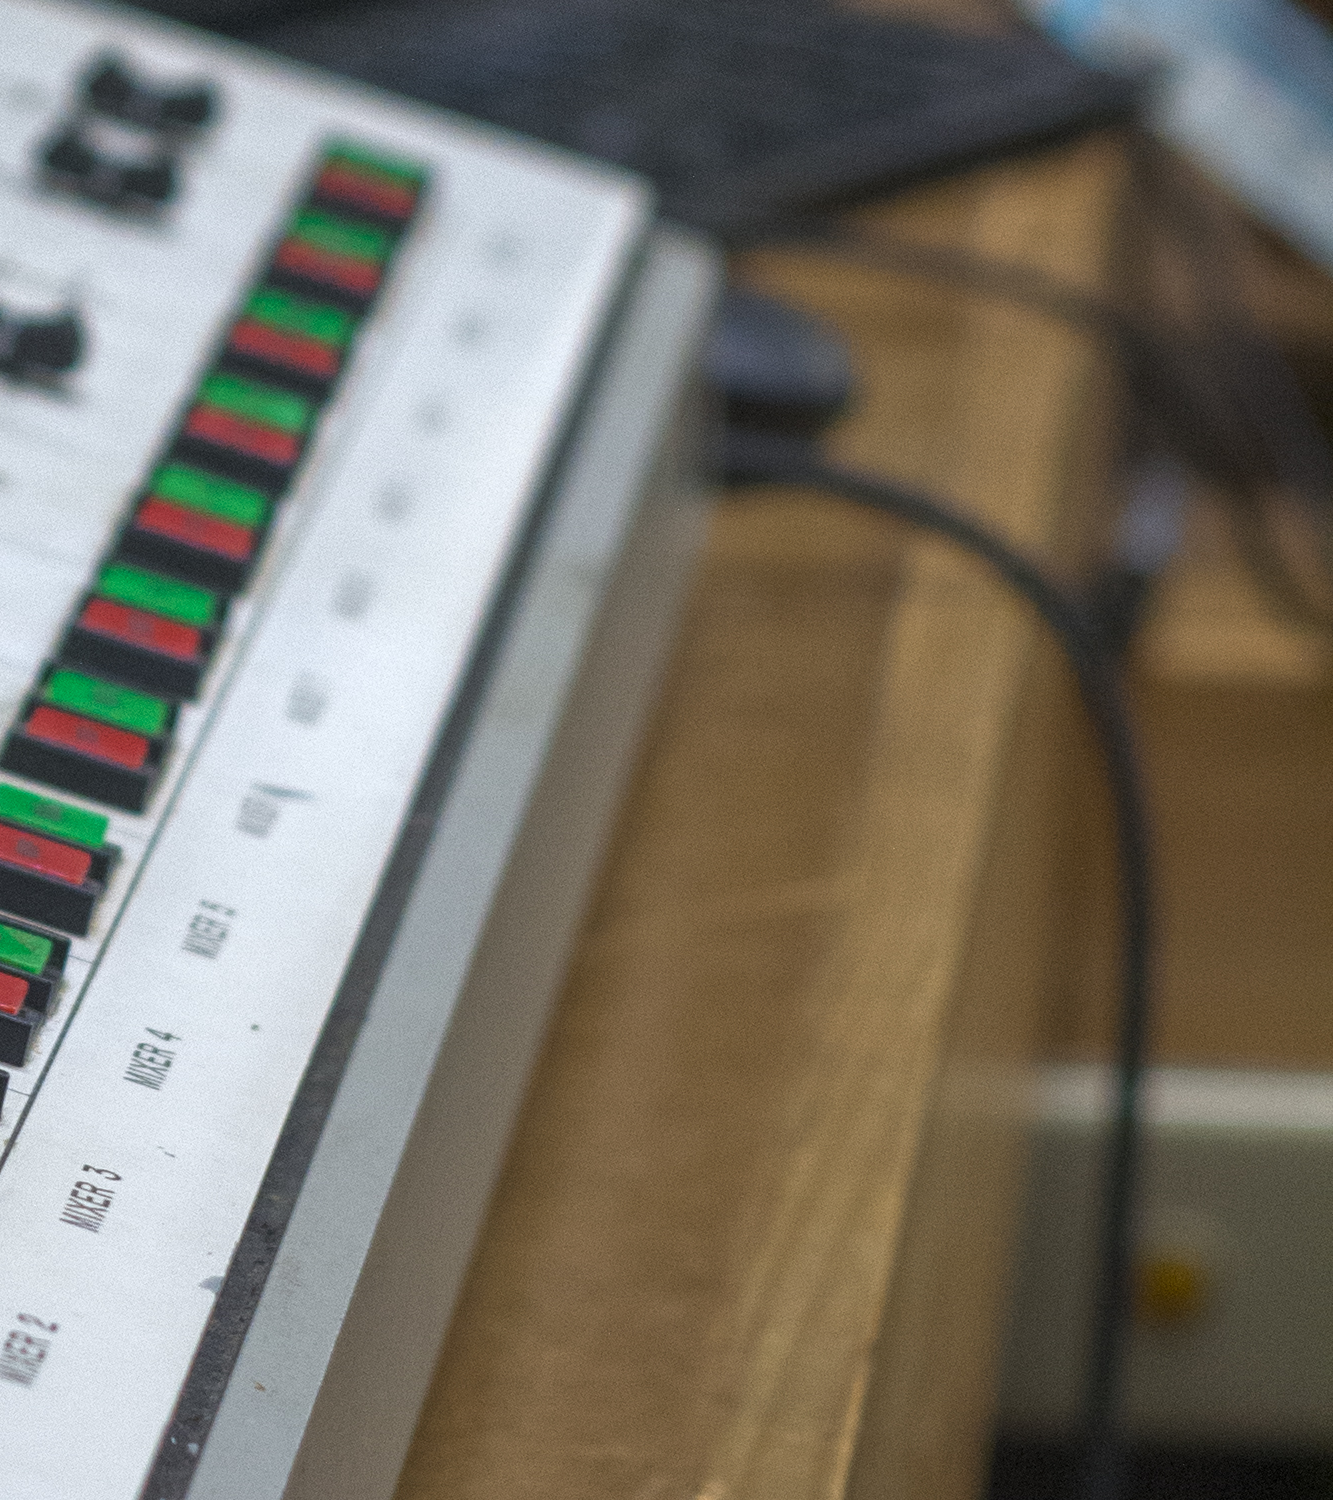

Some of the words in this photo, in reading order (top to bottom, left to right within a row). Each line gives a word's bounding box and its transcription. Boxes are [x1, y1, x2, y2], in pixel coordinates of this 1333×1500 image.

[145, 1026, 182, 1042] 4
[123, 1042, 176, 1091] MIXER
[82, 1163, 123, 1182] 3
[59, 1181, 116, 1234] MIXER
[16, 1312, 60, 1335] 2
